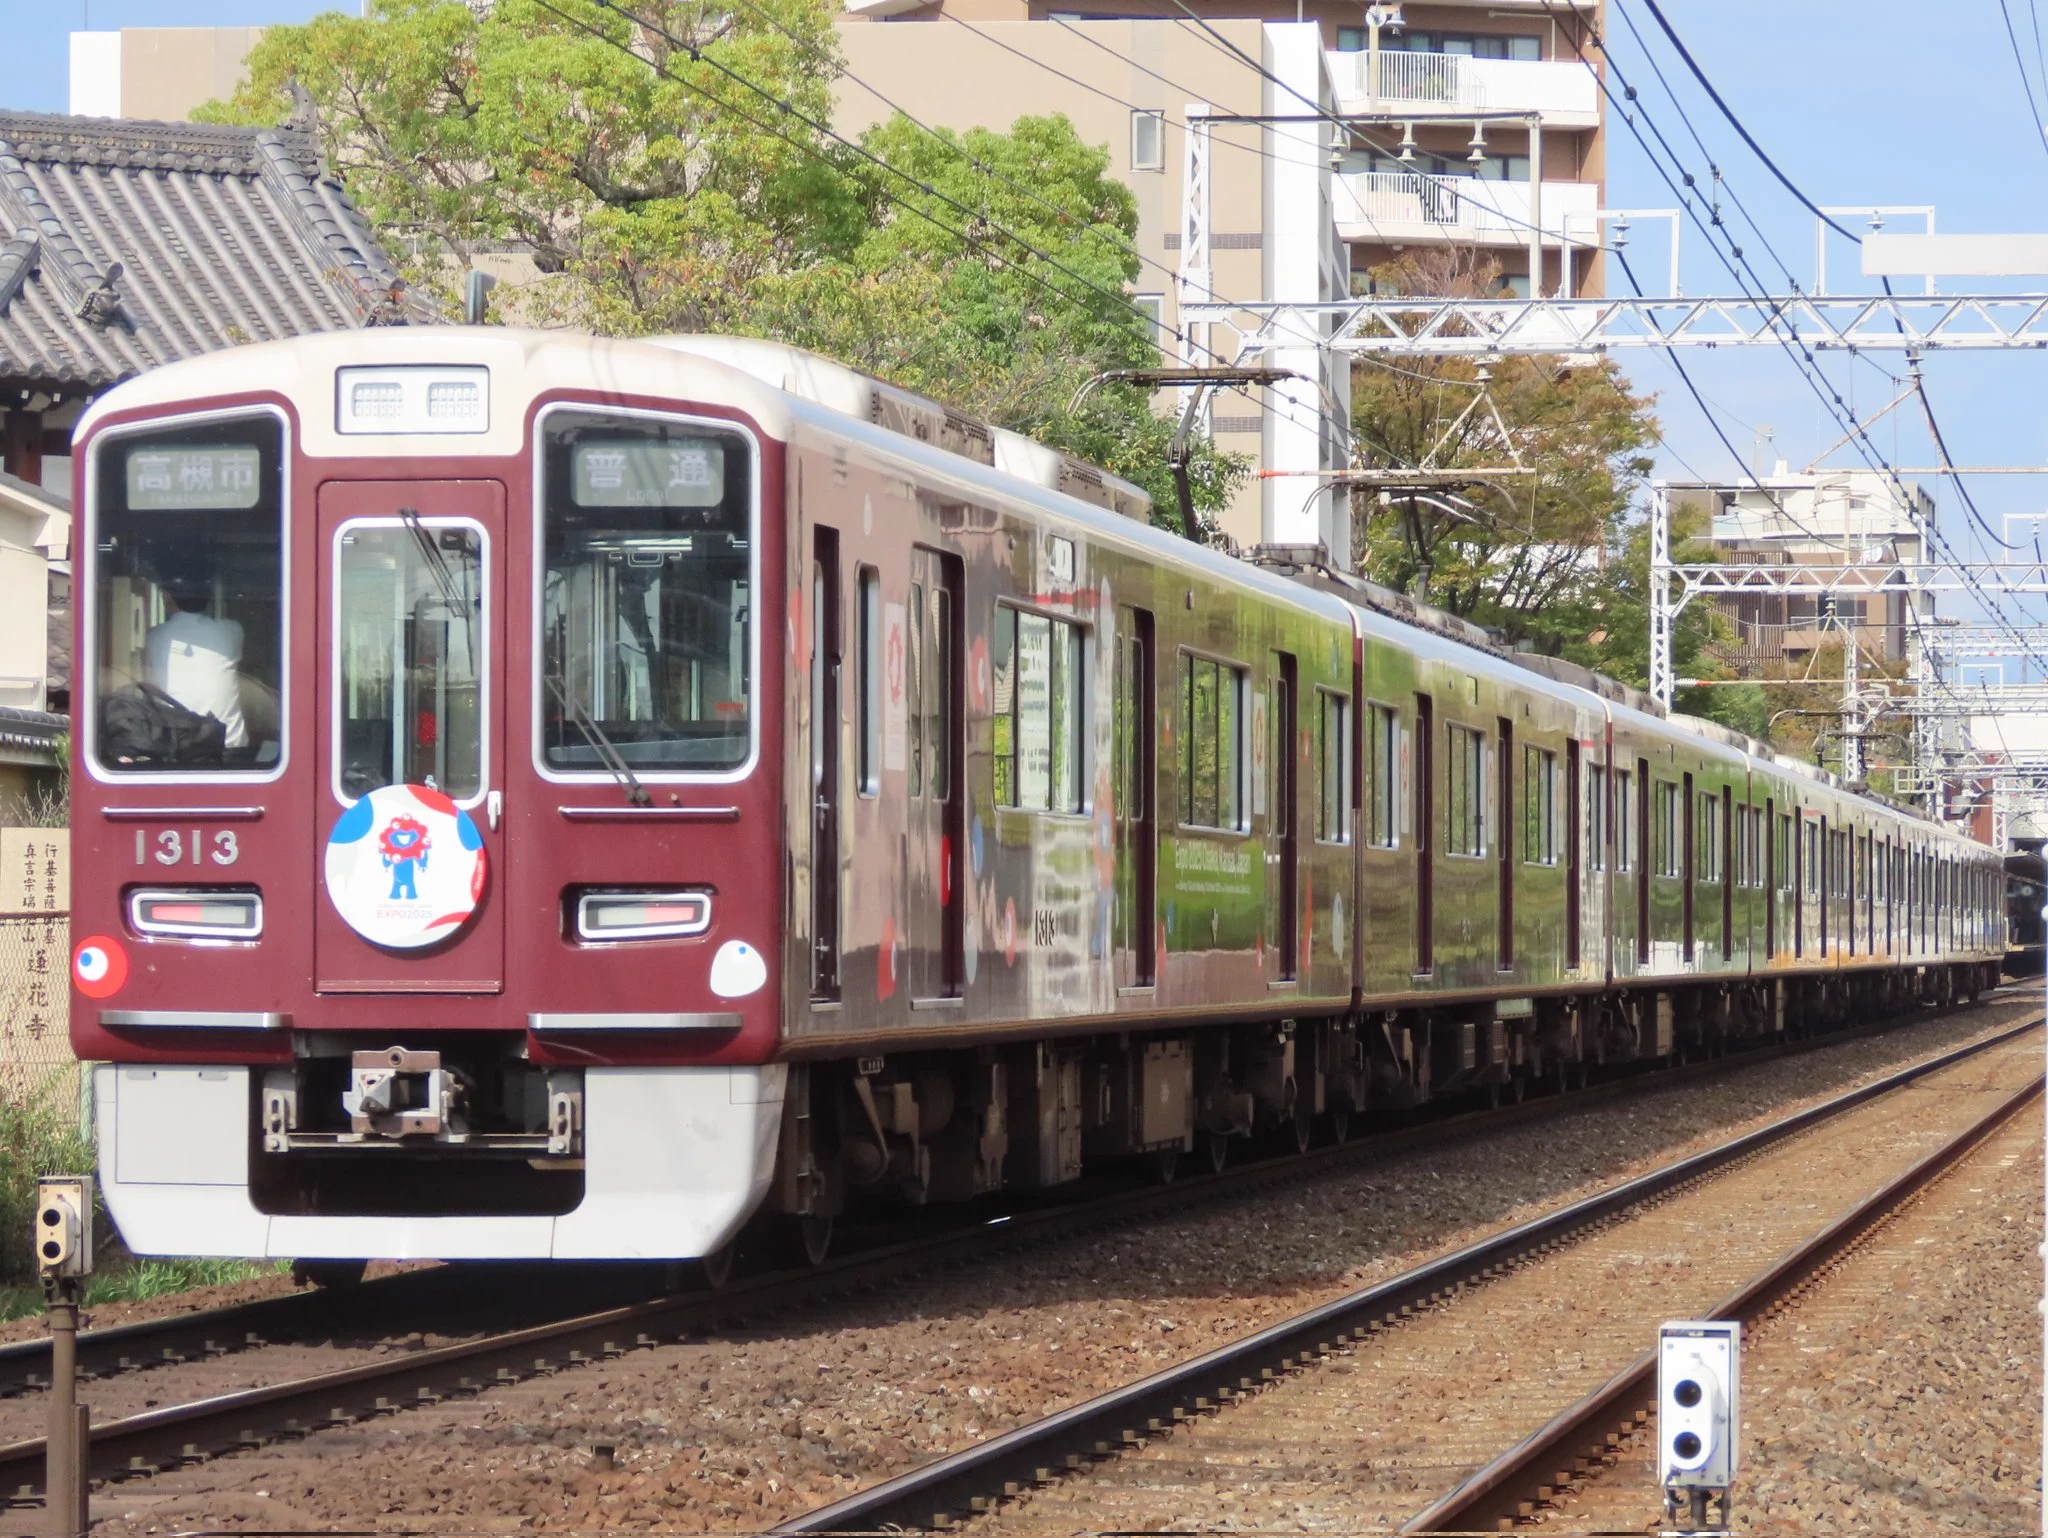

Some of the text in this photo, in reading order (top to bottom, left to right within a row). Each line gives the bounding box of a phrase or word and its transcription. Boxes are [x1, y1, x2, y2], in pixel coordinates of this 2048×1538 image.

[136, 453, 255, 491] 高槻市
[586, 450, 710, 488] 普通
[626, 488, 670, 502] Local
[135, 830, 240, 866] 1313
[376, 909, 433, 919] EXPO2025
[1035, 909, 1055, 947] 1313
[25, 948, 49, 1041] 蓮花寺
